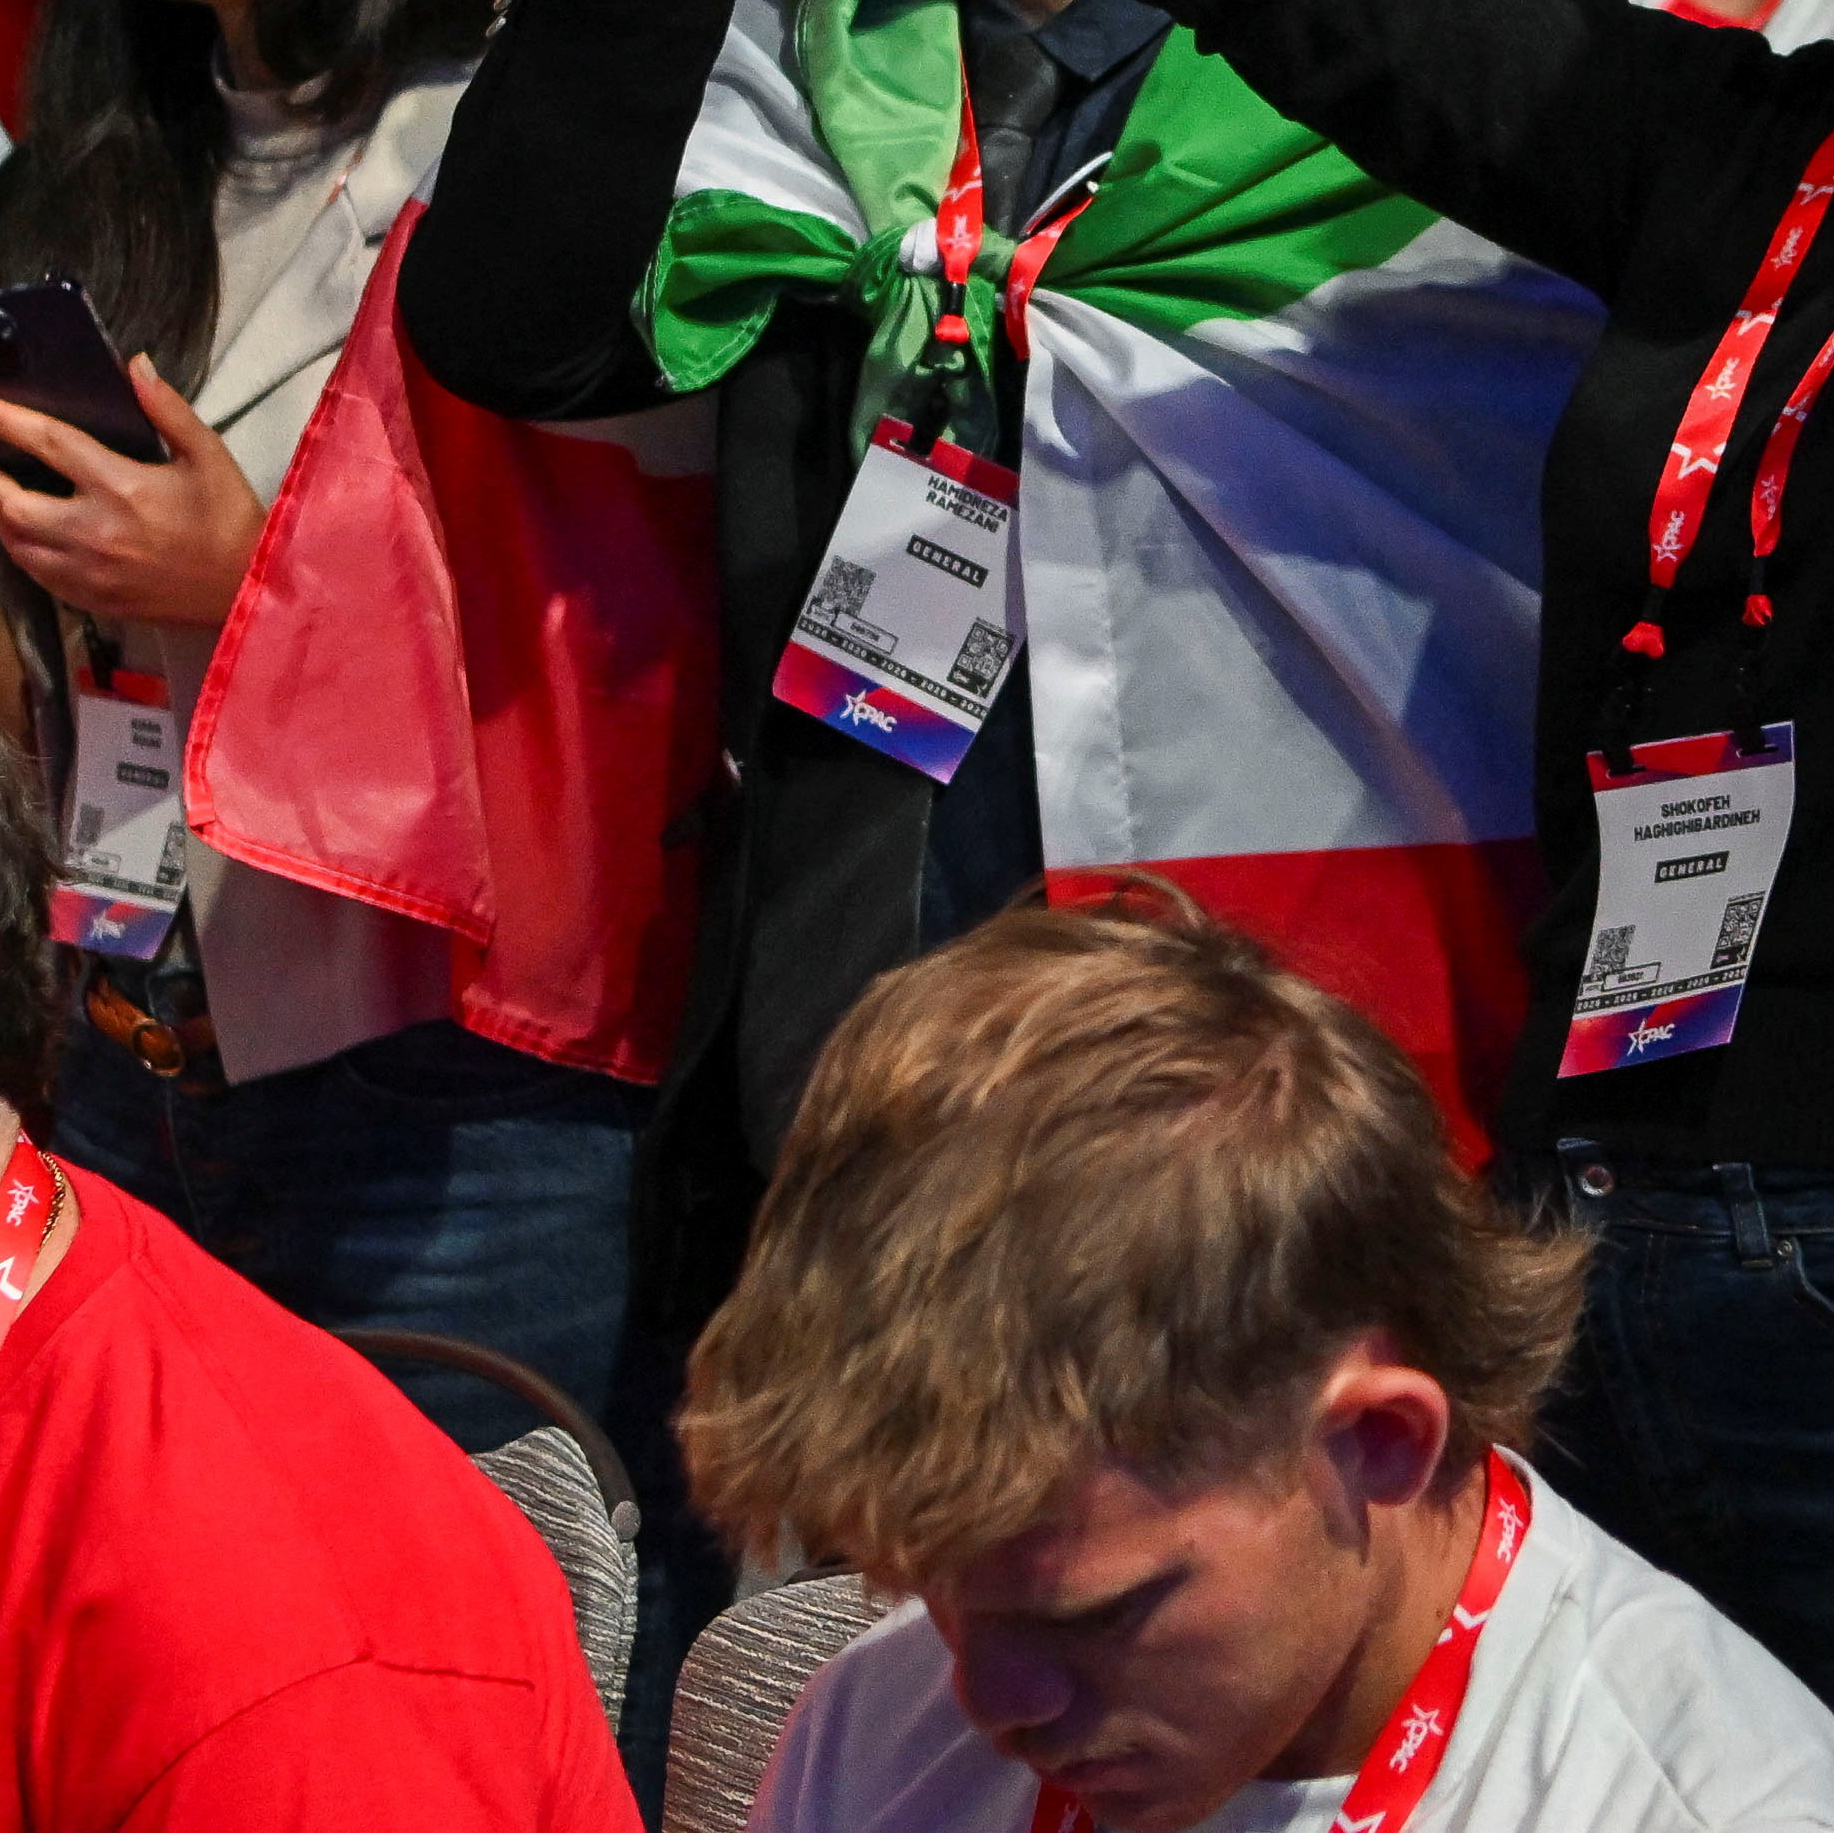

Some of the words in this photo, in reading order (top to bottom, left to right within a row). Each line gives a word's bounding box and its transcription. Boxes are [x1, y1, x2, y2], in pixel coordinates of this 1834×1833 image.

[912, 540, 981, 583] GENERAL
[850, 697, 898, 733] CPAC
[1661, 794, 1731, 819] SHOKOFEH
[1633, 808, 1761, 842] HAGHIGHIBARDINEH
[1659, 857, 1723, 879] GENERAL
[6, 1187, 33, 1227] CPAC
[1389, 1714, 1434, 1775] CPAC
